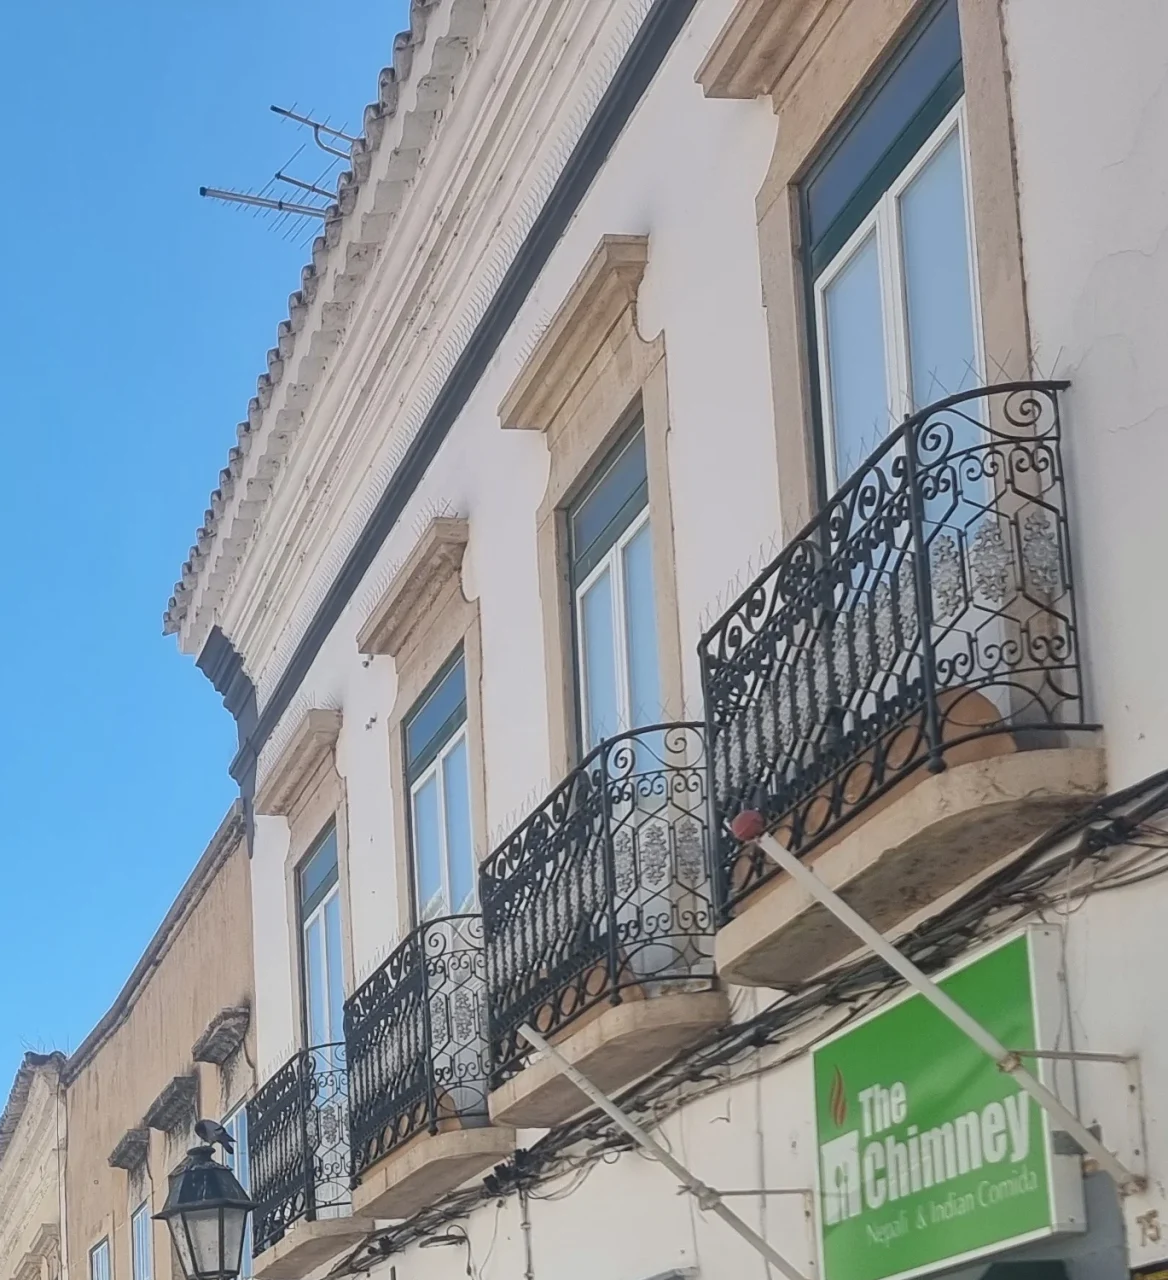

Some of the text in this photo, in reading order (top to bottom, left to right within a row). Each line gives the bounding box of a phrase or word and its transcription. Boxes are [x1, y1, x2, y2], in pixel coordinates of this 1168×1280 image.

[858, 1081, 907, 1138] The
[864, 1090, 1030, 1209] Chimney
[930, 1192, 975, 1222] Indian
